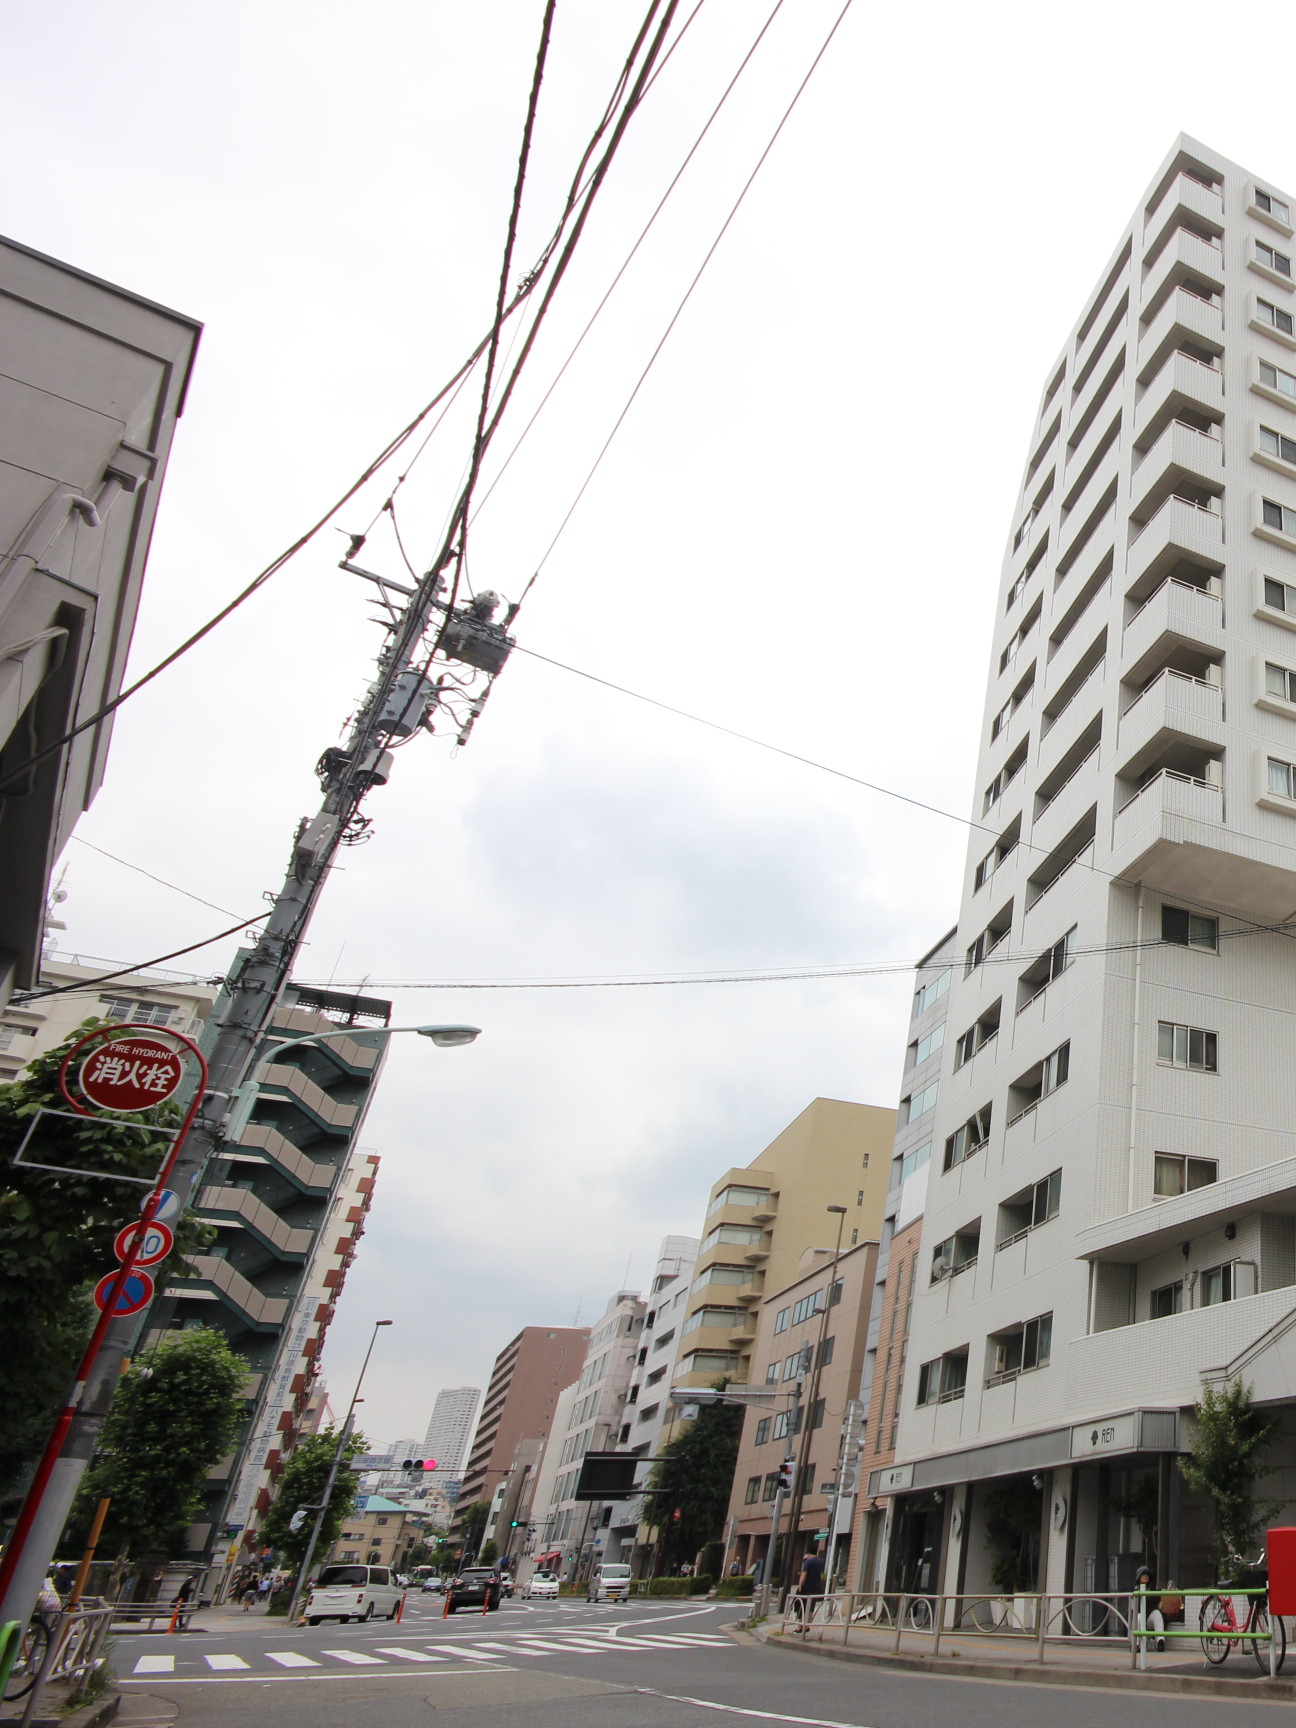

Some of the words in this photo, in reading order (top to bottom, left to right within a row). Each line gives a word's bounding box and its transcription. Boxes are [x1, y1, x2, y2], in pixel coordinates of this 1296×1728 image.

[109, 1043, 131, 1054] FIRE
[132, 1047, 175, 1060] HYDRANT
[89, 1055, 175, 1092] 消火栓
[1101, 1427, 1115, 1444] REN
